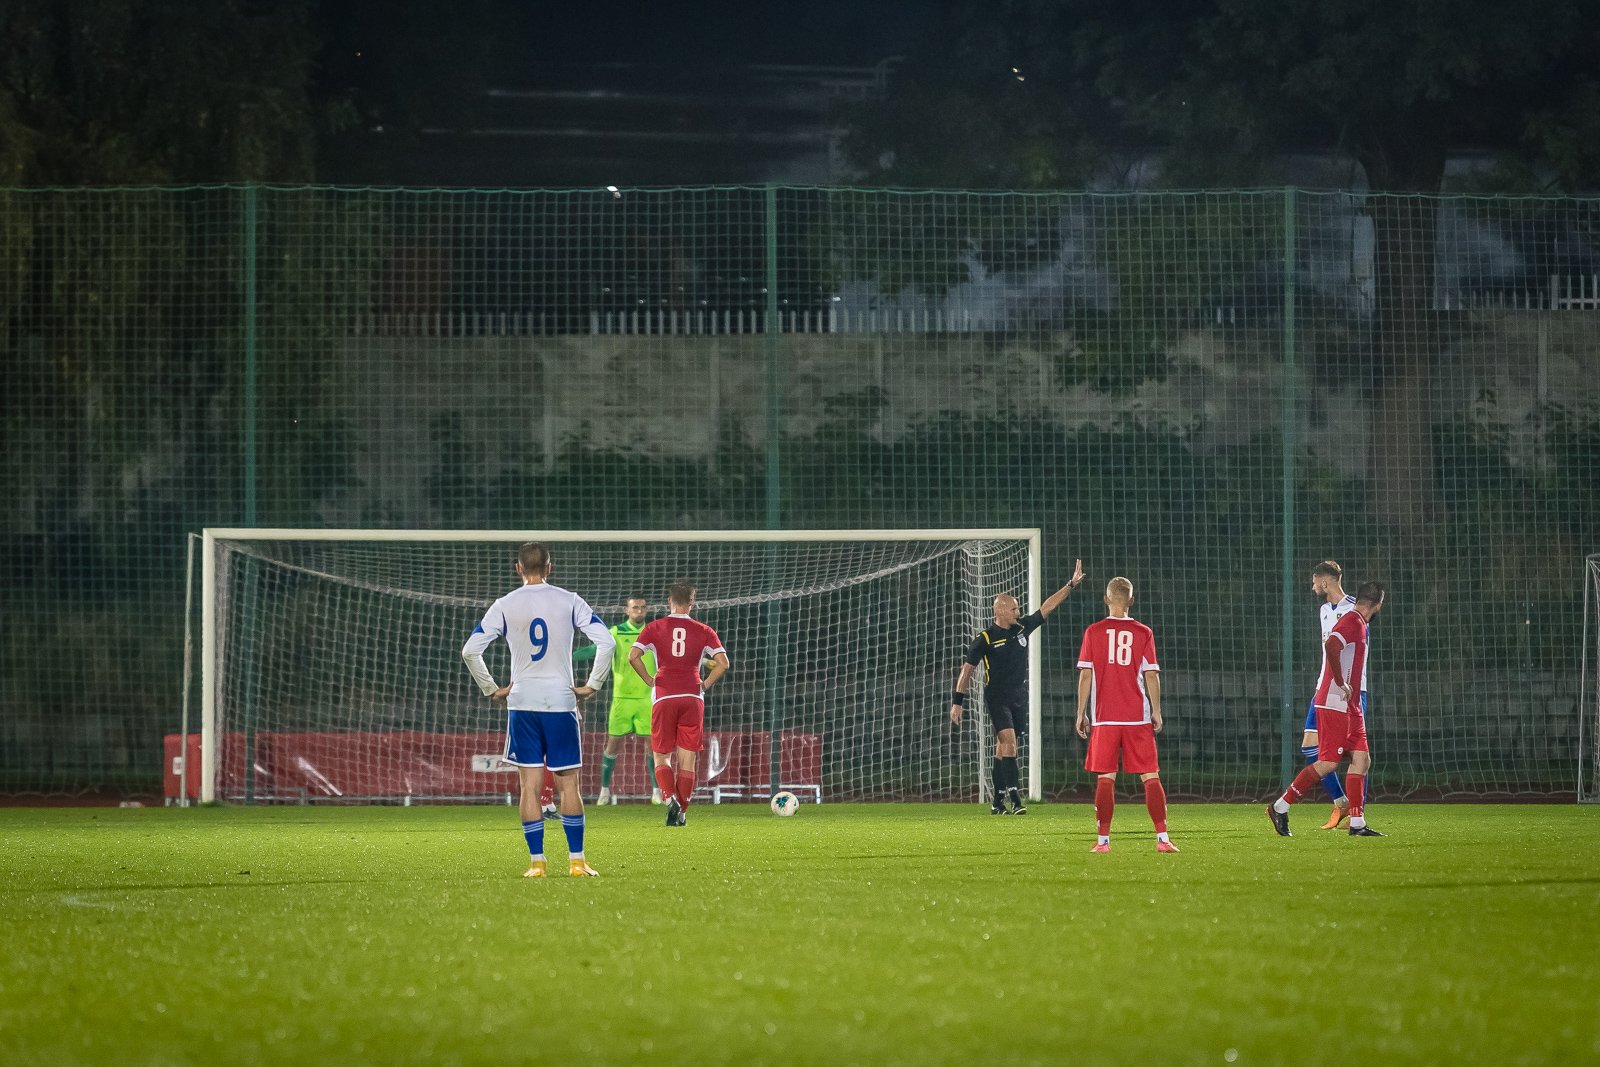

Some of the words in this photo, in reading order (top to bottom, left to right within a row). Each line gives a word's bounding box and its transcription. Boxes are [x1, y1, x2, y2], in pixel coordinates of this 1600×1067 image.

[529, 617, 549, 662] 9
[672, 627, 687, 657] 8
[1106, 628, 1133, 666] 18
